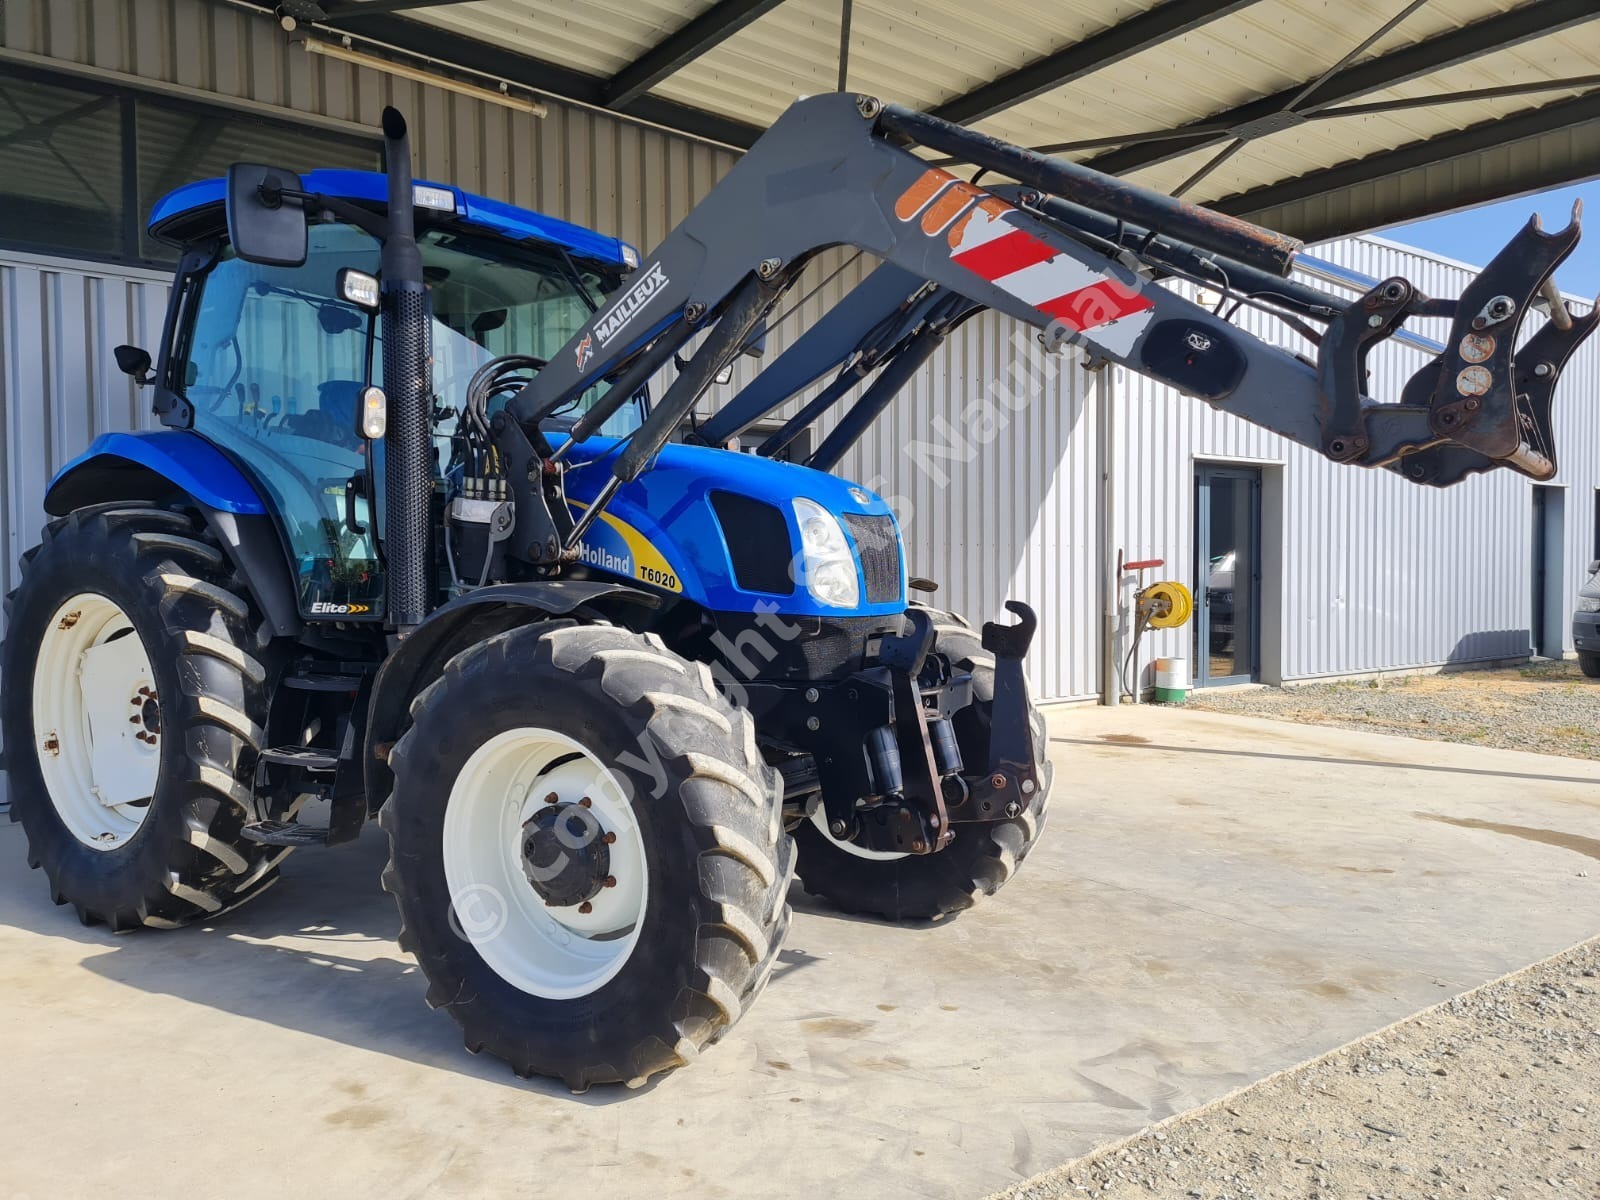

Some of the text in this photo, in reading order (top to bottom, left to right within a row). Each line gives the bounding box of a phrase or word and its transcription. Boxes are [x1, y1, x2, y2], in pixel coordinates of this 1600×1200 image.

[595, 265, 668, 342] MAILLEUX
[581, 542, 630, 574] Holland
[640, 565, 676, 589] T6020
[310, 602, 348, 614] Elite
